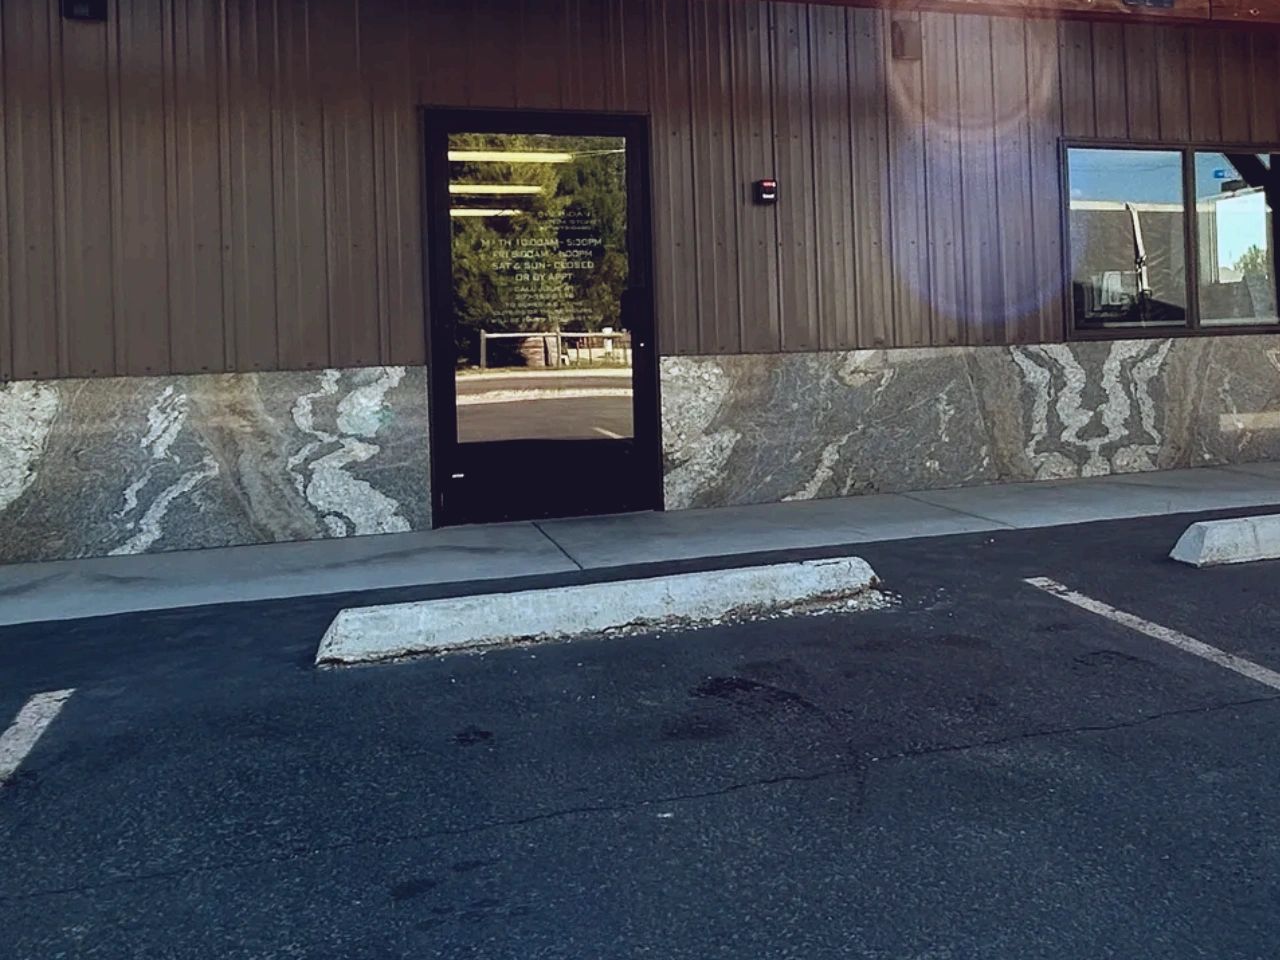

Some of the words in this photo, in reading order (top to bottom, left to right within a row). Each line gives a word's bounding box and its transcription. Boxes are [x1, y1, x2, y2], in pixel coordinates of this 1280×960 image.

[491, 261, 512, 270] SAT
[553, 261, 595, 269] CLOSED
[515, 272, 530, 281] OR
